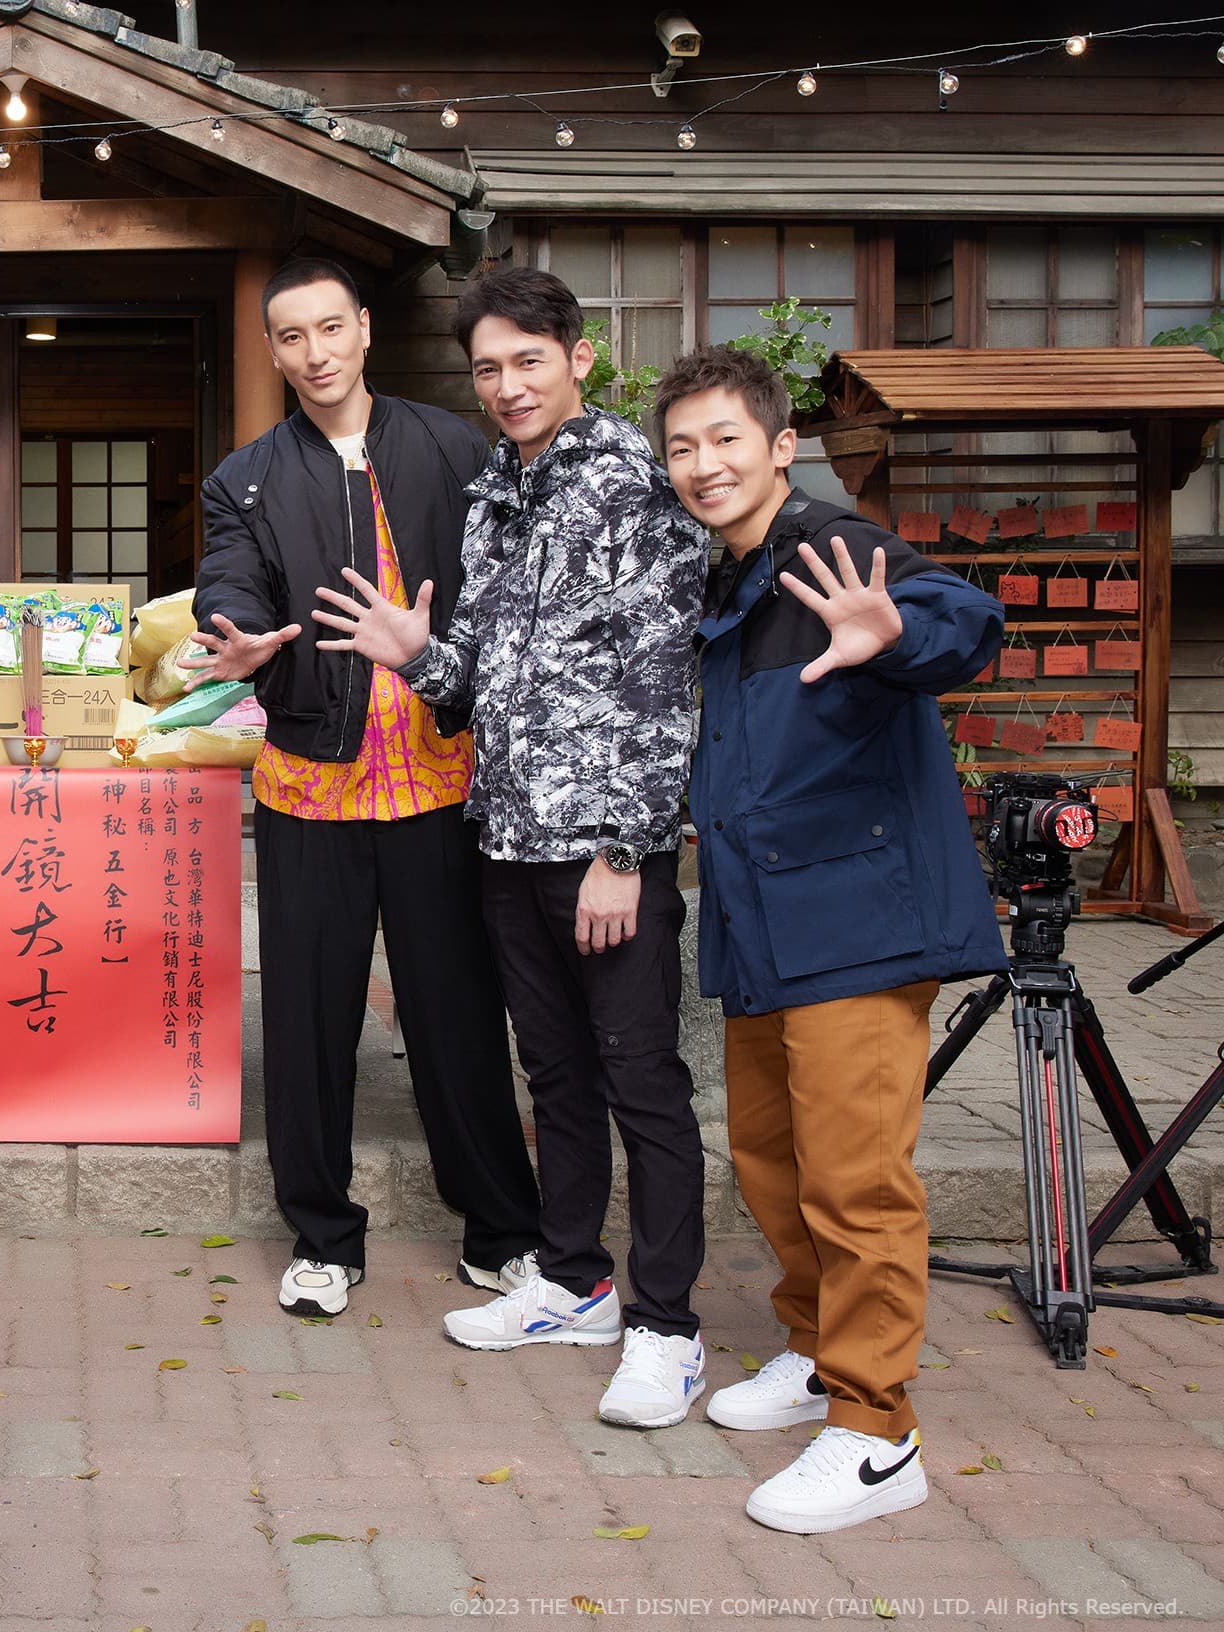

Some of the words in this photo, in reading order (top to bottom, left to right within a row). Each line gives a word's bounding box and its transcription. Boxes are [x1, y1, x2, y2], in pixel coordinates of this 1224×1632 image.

[1, 768, 72, 1033] 開鏡大吉
[162, 848, 180, 1049] 原也文化行銷有限公司
